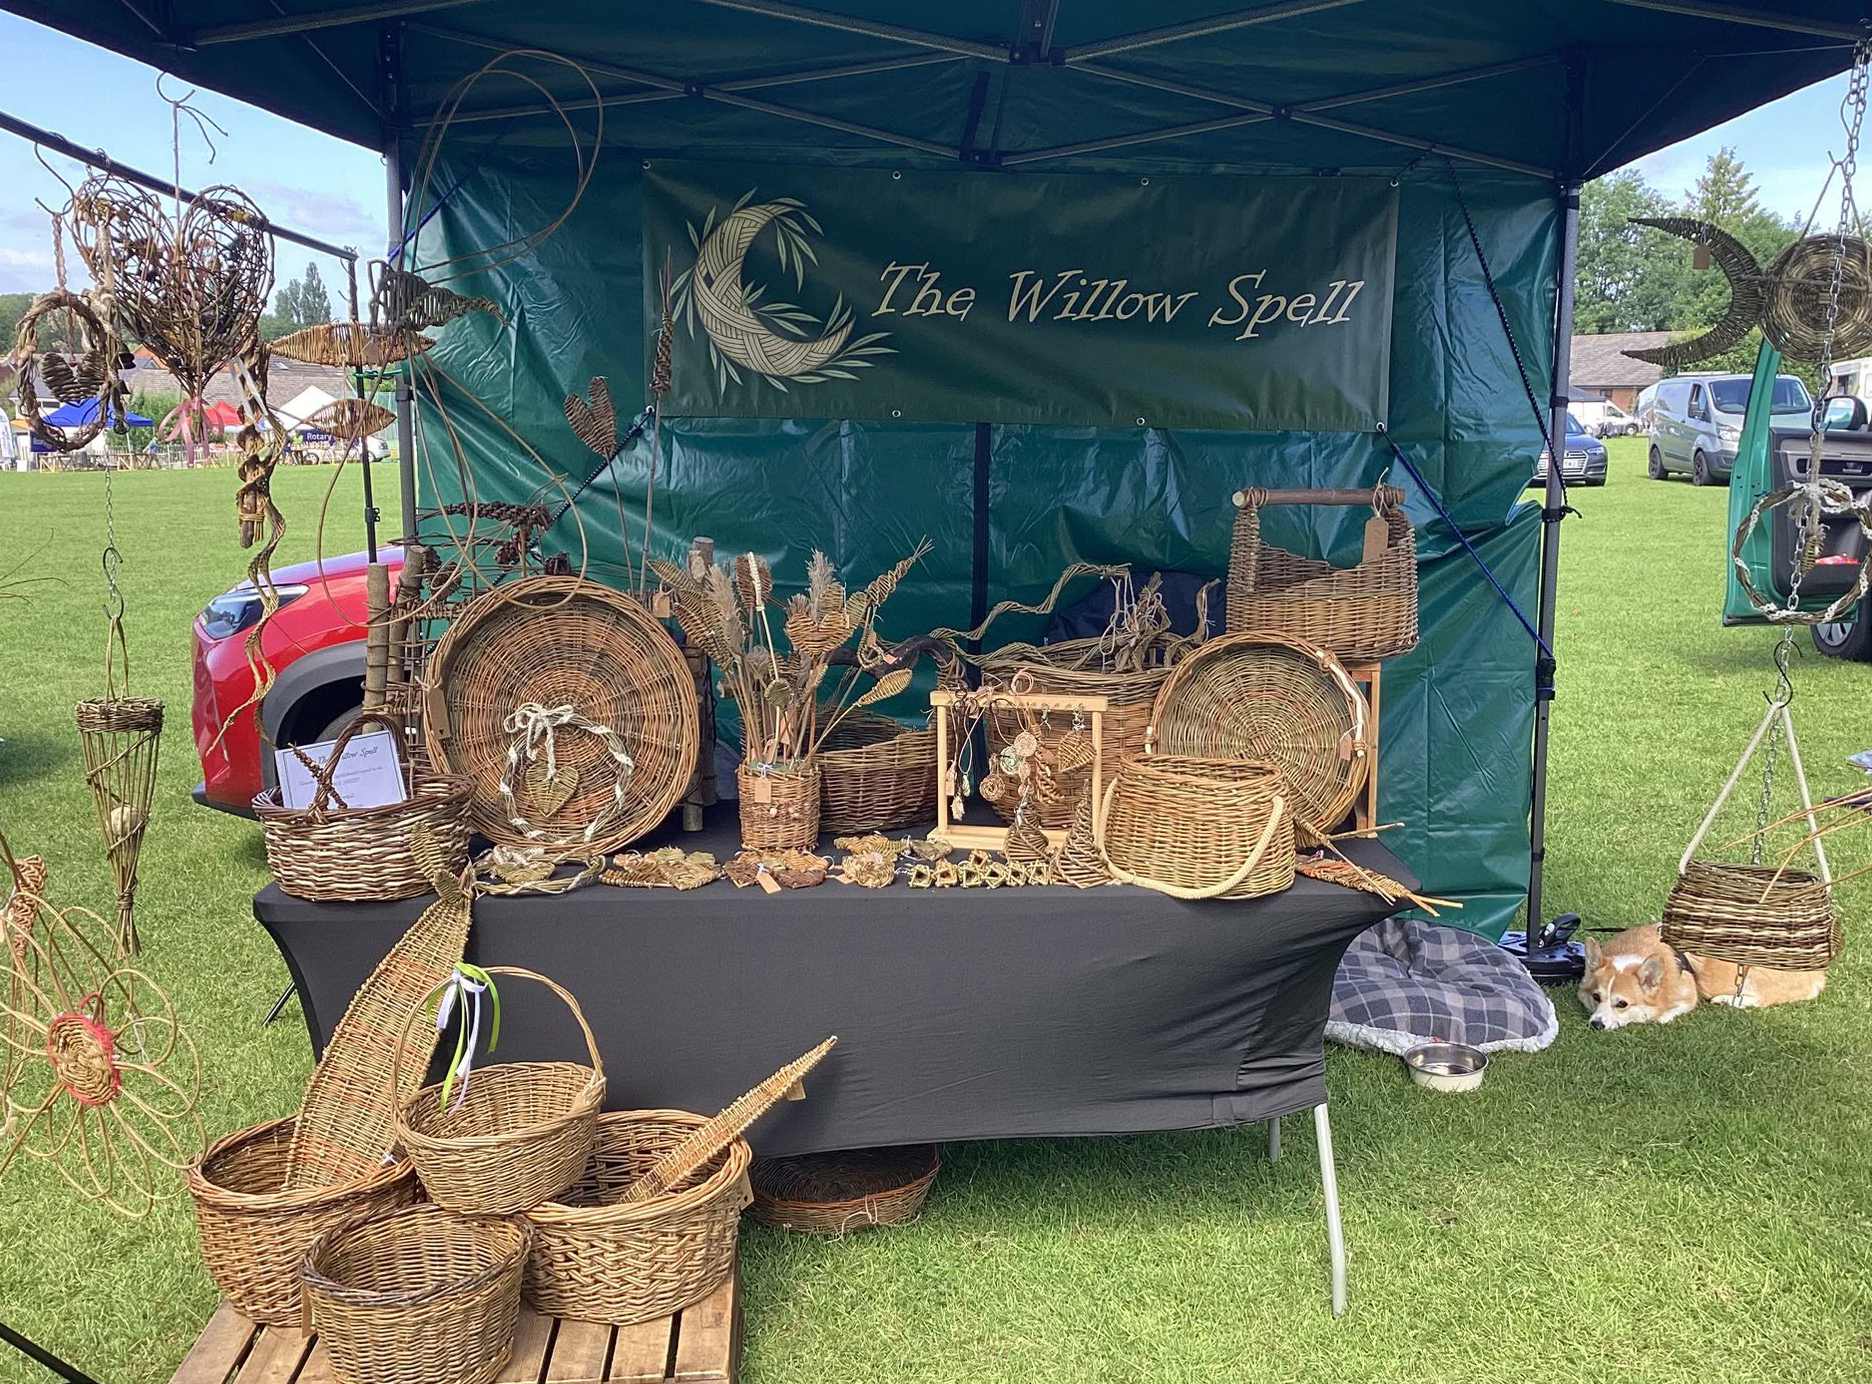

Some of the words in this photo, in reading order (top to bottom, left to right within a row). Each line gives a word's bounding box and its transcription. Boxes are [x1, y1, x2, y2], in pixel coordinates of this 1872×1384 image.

[871, 260, 977, 322] The
[1009, 269, 1199, 323] Willow
[1207, 268, 1365, 341] Spell
[306, 432, 332, 442] Rotary
[360, 746, 379, 758] Spell
